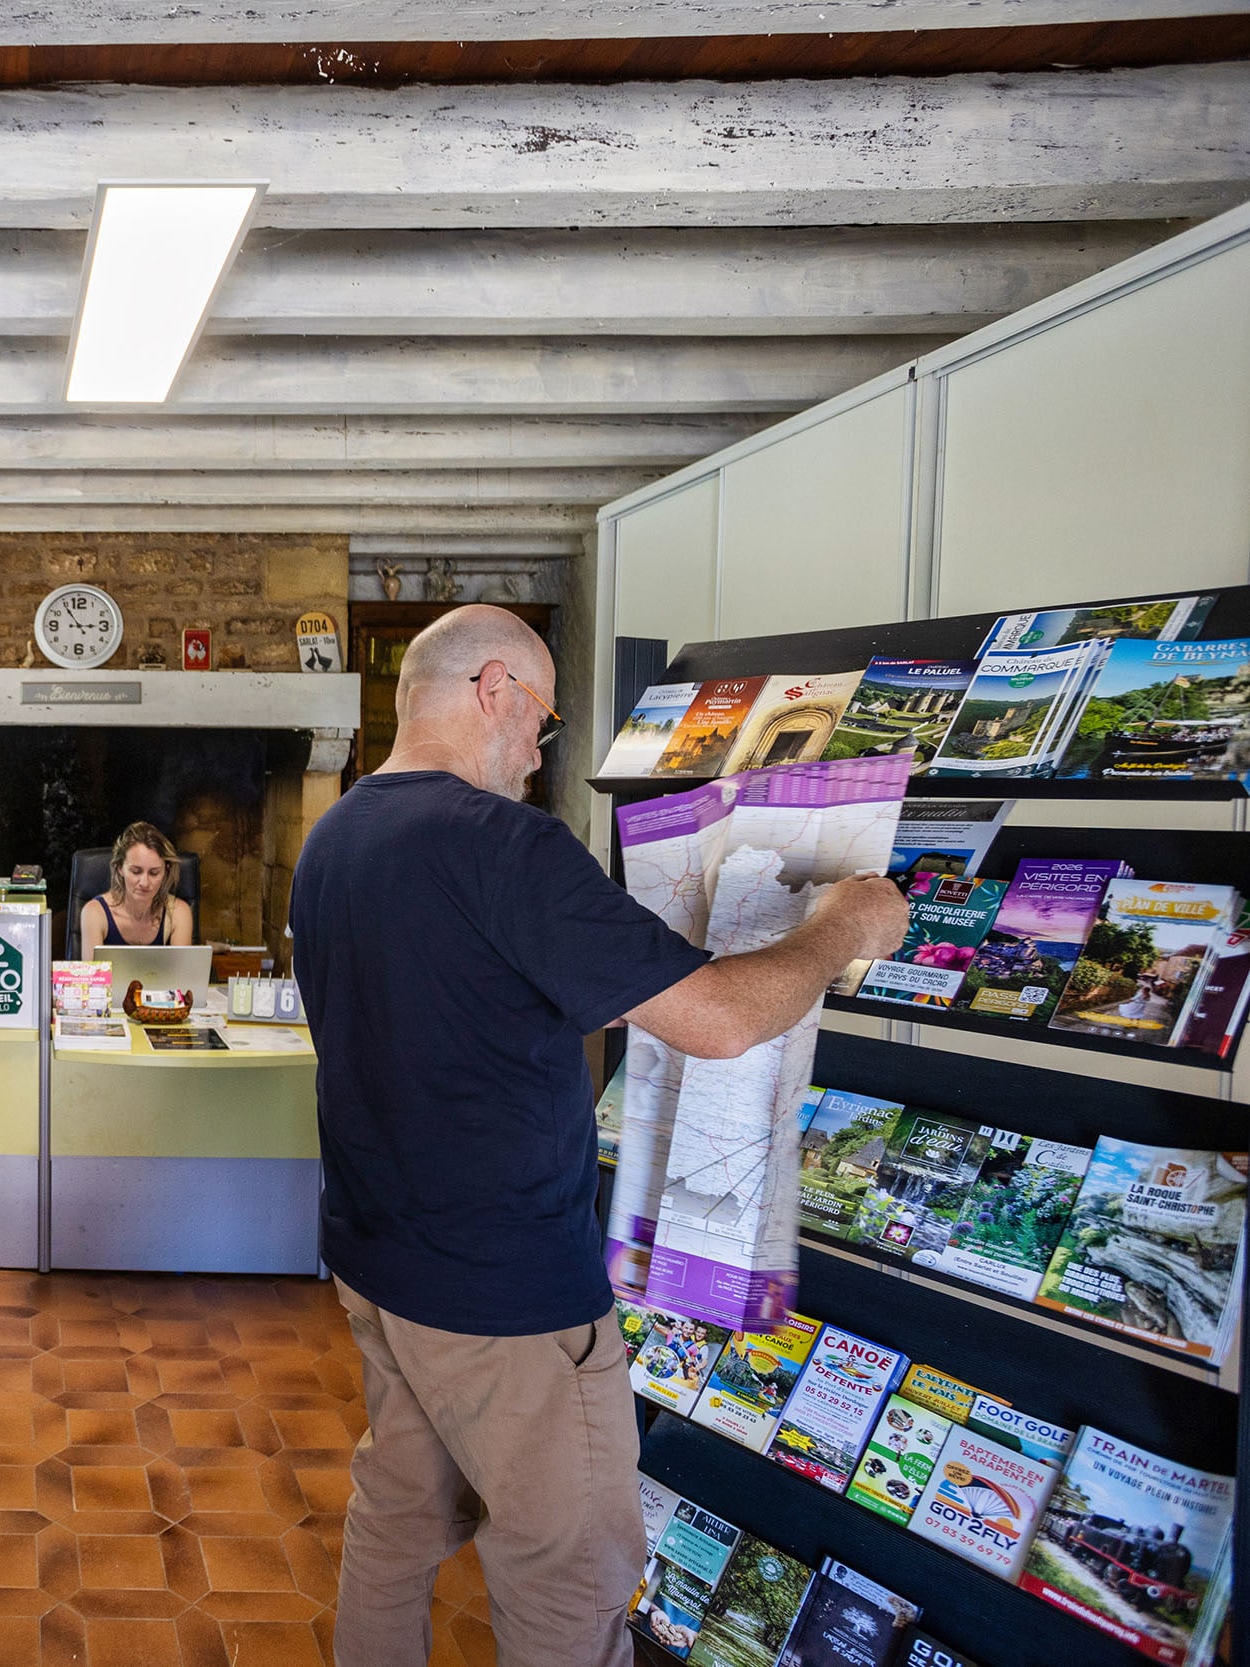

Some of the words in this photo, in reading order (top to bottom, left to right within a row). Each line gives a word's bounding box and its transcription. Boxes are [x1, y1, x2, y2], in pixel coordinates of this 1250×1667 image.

[71, 598, 87, 609] 12
[49, 620, 59, 632] 9
[99, 620, 109, 632] 3
[300, 620, 328, 634] D704
[74, 643, 84, 655] 6
[299, 636, 318, 646] SARLAT
[1156, 642, 1247, 652] GABARRES
[1152, 652, 1176, 660] DE
[981, 657, 1075, 673] COMMARQUE
[1024, 873, 1083, 882] VISITES
[1084, 874, 1108, 883] EN
[1019, 882, 1102, 893] PÉRIGORD
[918, 903, 988, 919] CHOCOLATERIE
[1123, 899, 1151, 910] PLAN
[1153, 902, 1170, 912] DE
[1174, 901, 1206, 914] VILLE
[920, 913, 941, 922] SON
[942, 916, 977, 927] MUSÉE
[878, 964, 906, 974] VOYAGE
[907, 968, 950, 980] GOURMAND
[888, 973, 907, 981] PAYS
[922, 978, 948, 988] CACAO
[280, 988, 295, 1012] 6
[981, 990, 1018, 1000] PASS
[826, 1095, 894, 1120] Eyrignac
[909, 1132, 963, 1152] d'eau
[918, 1126, 964, 1144] JARDINS
[815, 1189, 836, 1199] PLUS
[1130, 1183, 1144, 1194] LA
[1148, 1186, 1182, 1201] ROQUE
[813, 1196, 843, 1209] JARDIN
[1126, 1193, 1216, 1216] SAINT-CHRISTOPHE
[979, 1258, 1006, 1269] CARLUX
[823, 1336, 893, 1371] CANOË
[805, 1386, 815, 1394] 05
[817, 1391, 827, 1400] 53
[828, 1396, 839, 1405] 29
[840, 1402, 851, 1411] 52
[853, 1407, 863, 1416] 15
[975, 1411, 1012, 1435] DOMAINE
[1013, 1428, 1025, 1439] DE
[1025, 1431, 1037, 1442] LA
[977, 1401, 1023, 1426] FOOT
[1024, 1420, 1070, 1444] GOLF
[962, 1450, 1036, 1489] PARAPENTE
[1092, 1435, 1150, 1469] TRAIN
[1171, 1470, 1232, 1496] MARTEL
[1026, 1470, 1045, 1483] EN
[1092, 1461, 1106, 1473] UN
[1108, 1468, 1143, 1490] VOYAGE
[1145, 1483, 1172, 1502] PLEIN
[703, 1515, 731, 1535] ATELIER
[930, 1502, 1018, 1550] GOT2FLY
[925, 1517, 941, 1529] 07
[942, 1525, 957, 1538] 83
[959, 1534, 975, 1546] 39
[977, 1544, 994, 1556] 69
[996, 1553, 1012, 1566] 79
[675, 1579, 700, 1598] moulin
